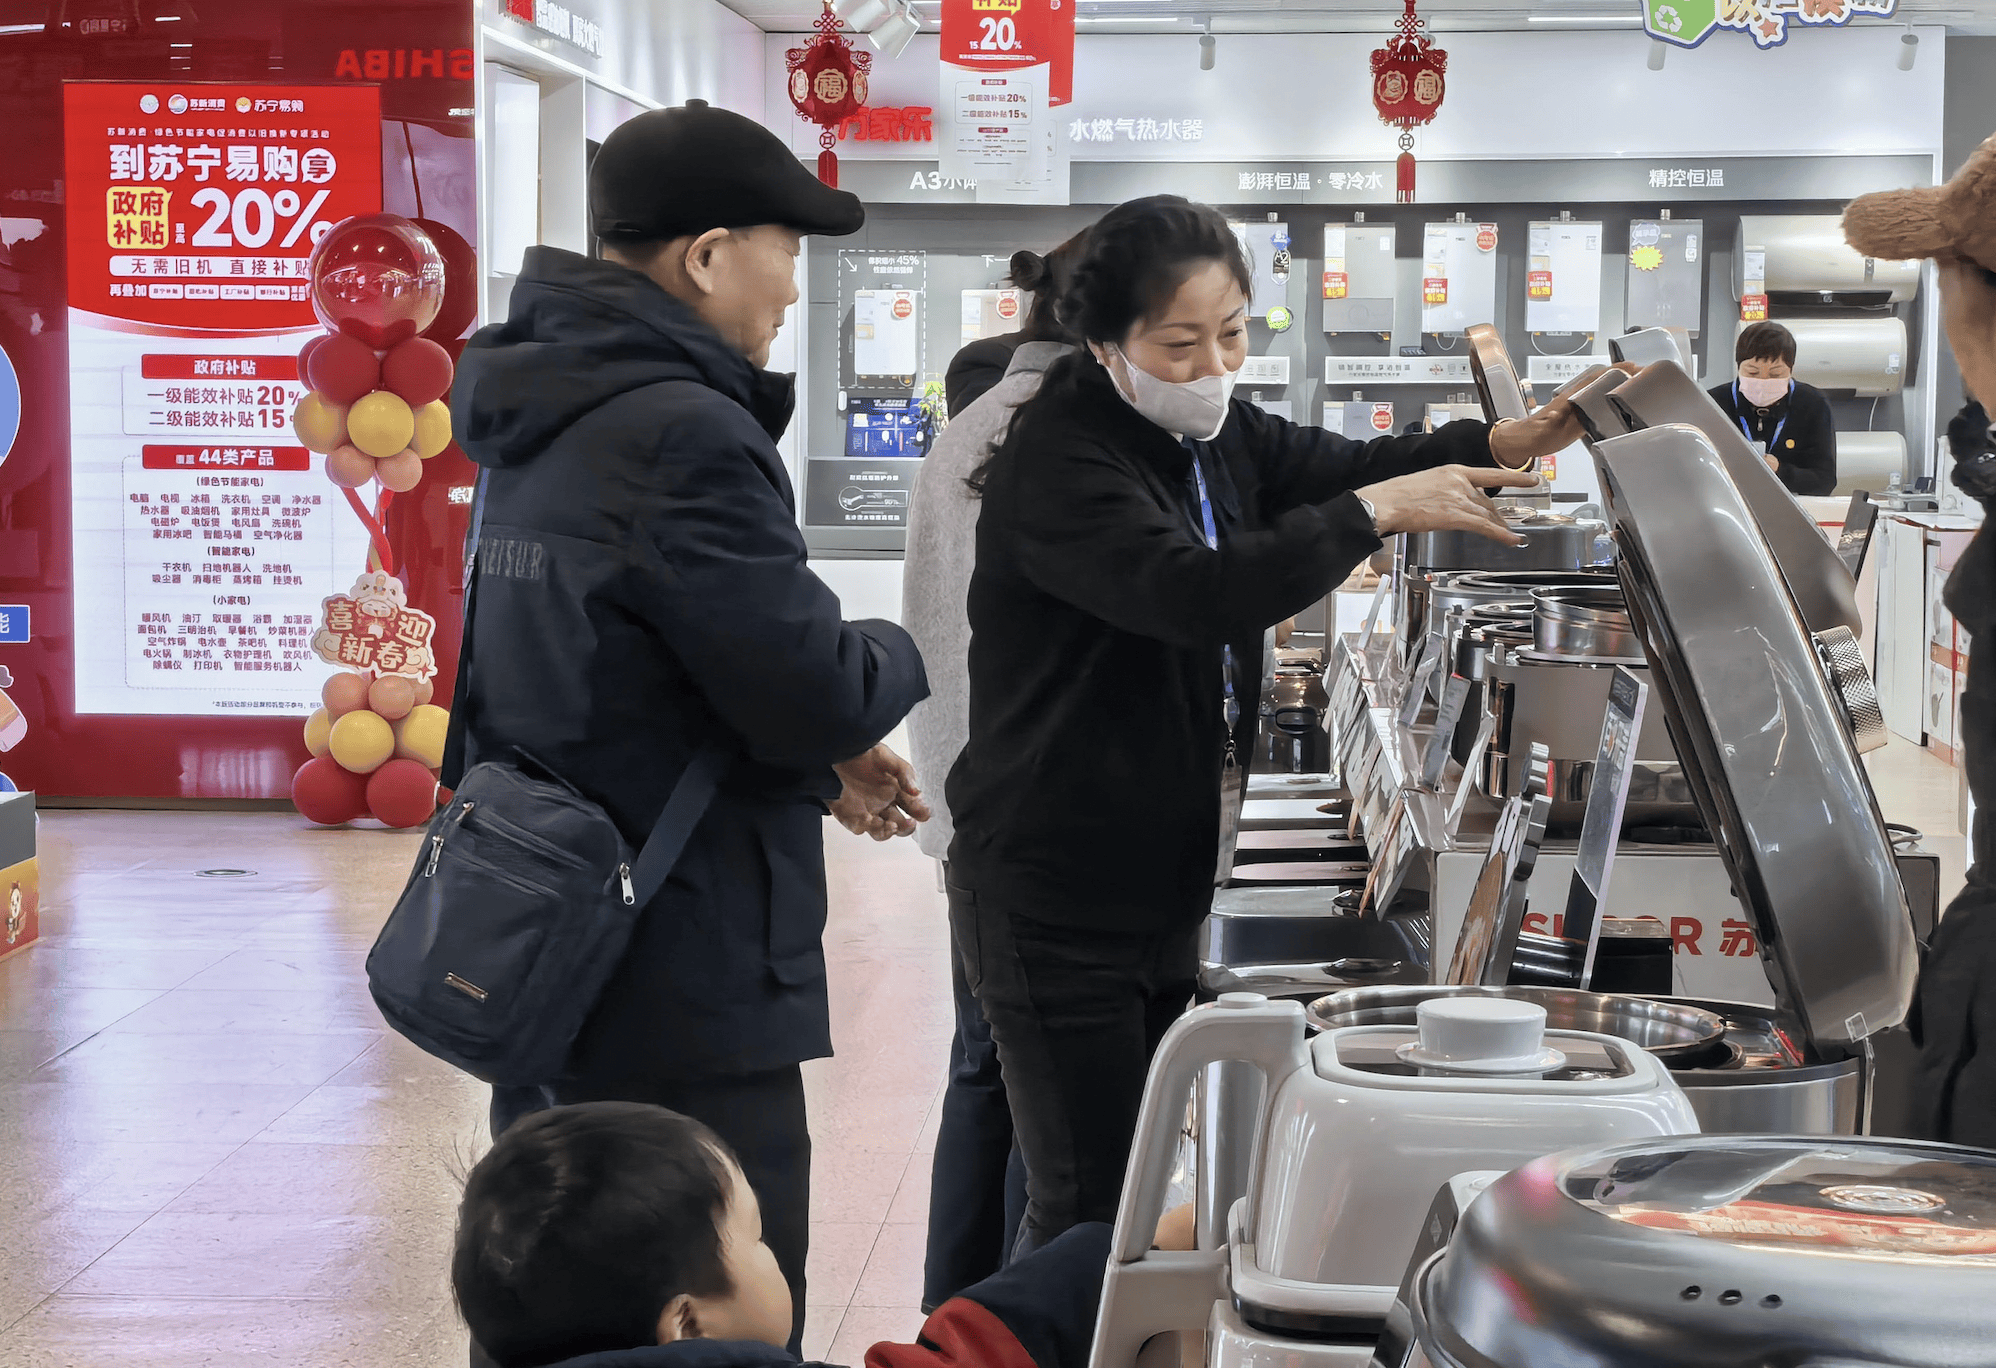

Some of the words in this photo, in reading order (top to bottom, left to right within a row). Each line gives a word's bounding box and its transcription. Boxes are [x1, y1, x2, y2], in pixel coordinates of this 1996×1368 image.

[819, 73, 842, 98] 福
[254, 100, 304, 112] 苏宁易购
[1069, 118, 1205, 142] 水燃气热水器
[1649, 169, 1724, 188] 精控恒温
[112, 191, 164, 216] 政府
[190, 187, 334, 249] 20%
[113, 220, 164, 245] 补贴
[175, 223, 186, 244] 至高
[131, 258, 212, 275] 无需旧机
[230, 259, 310, 276] 直接补贴
[110, 284, 147, 297] 再叠加
[194, 360, 256, 375] 政府补贴
[147, 386, 300, 406] 一级能效补贴20%
[149, 409, 294, 428] 二级能效补贴15
[130, 494, 150, 503] 电脑
[160, 494, 180, 504] 电视
[191, 494, 210, 504] 冰箱
[222, 494, 251, 504] 洗衣机
[262, 495, 280, 504] 空调
[292, 495, 321, 505] 净水器
[140, 506, 170, 515] 热水器
[181, 506, 220, 516] 吸油烟机
[231, 506, 270, 516] 家用灶具
[282, 507, 311, 516] 微波炉
[151, 518, 180, 527] 电磁炉
[192, 518, 220, 527] 电饭煲
[232, 518, 260, 528] 电风扇
[272, 518, 302, 528] 洗碗机
[152, 529, 192, 539] 家用冰吧
[204, 530, 242, 540] 智能马桶
[253, 530, 302, 540] 空气净化器
[162, 562, 192, 572] 干衣机
[202, 563, 251, 572] 扫地机器人
[262, 564, 292, 573] 洗地机
[152, 574, 181, 584] 吸尘器
[192, 574, 222, 584] 消毒柜
[232, 575, 262, 584] 蒸烤箱
[273, 576, 302, 585] 挂烫机
[212, 595, 250, 606] (小家电)
[142, 613, 171, 623] 暖风机
[182, 614, 201, 623] 油汀
[212, 614, 241, 624] 取暖器
[252, 614, 272, 624] 浴霸
[284, 614, 312, 624] 加湿器
[138, 625, 166, 634] 面包机
[178, 626, 216, 635] 三明治机
[228, 626, 257, 636] 早餐机
[268, 626, 314, 636] 炒菜机器人
[148, 637, 186, 646] 空气炸锅
[198, 638, 226, 647] 电水壶
[238, 638, 267, 648] 茶吧机
[278, 638, 308, 648] 料理机
[143, 648, 172, 658] 电火锅
[183, 649, 212, 659] 制冰机
[224, 650, 272, 660] 衣物护理机
[283, 650, 312, 660] 吹风机
[153, 660, 182, 670] 除螨仪
[194, 661, 223, 670] 打印机
[234, 662, 302, 672] 智能服务机器人
[1719, 918, 1757, 957] 苏
